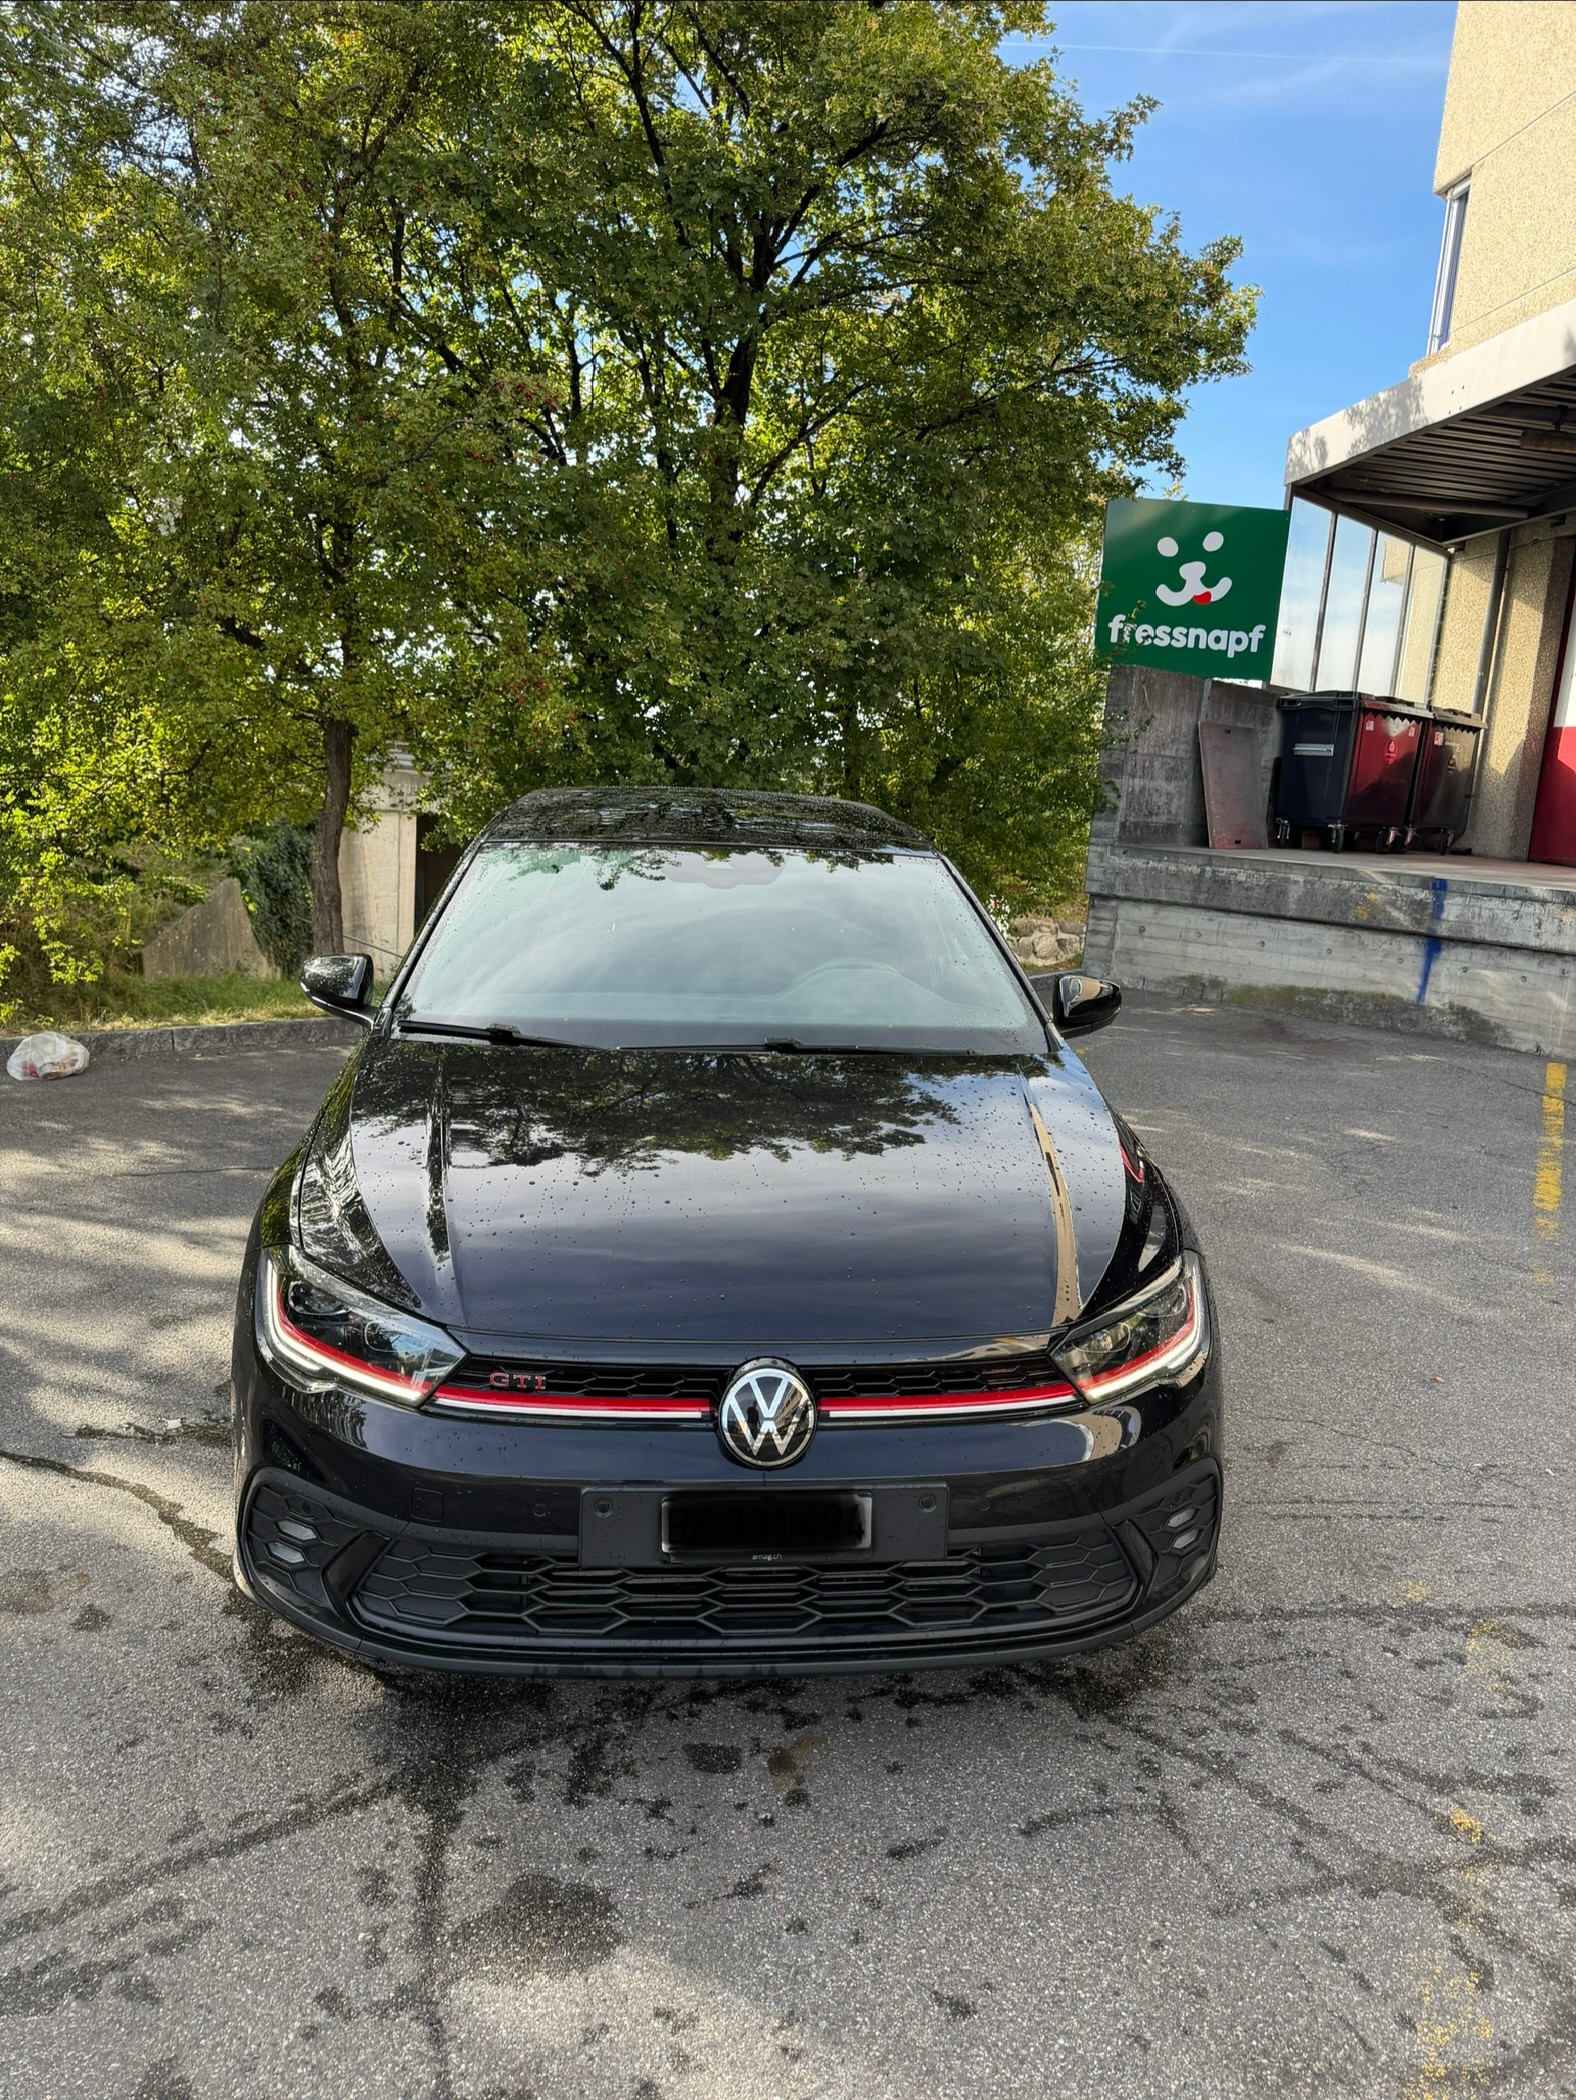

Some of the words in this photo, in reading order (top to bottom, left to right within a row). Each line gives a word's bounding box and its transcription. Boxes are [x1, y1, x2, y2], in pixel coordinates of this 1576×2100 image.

[1107, 613, 1267, 659] fressnapf
[489, 1372, 547, 1390] GTI
[726, 1373, 811, 1459] VW
